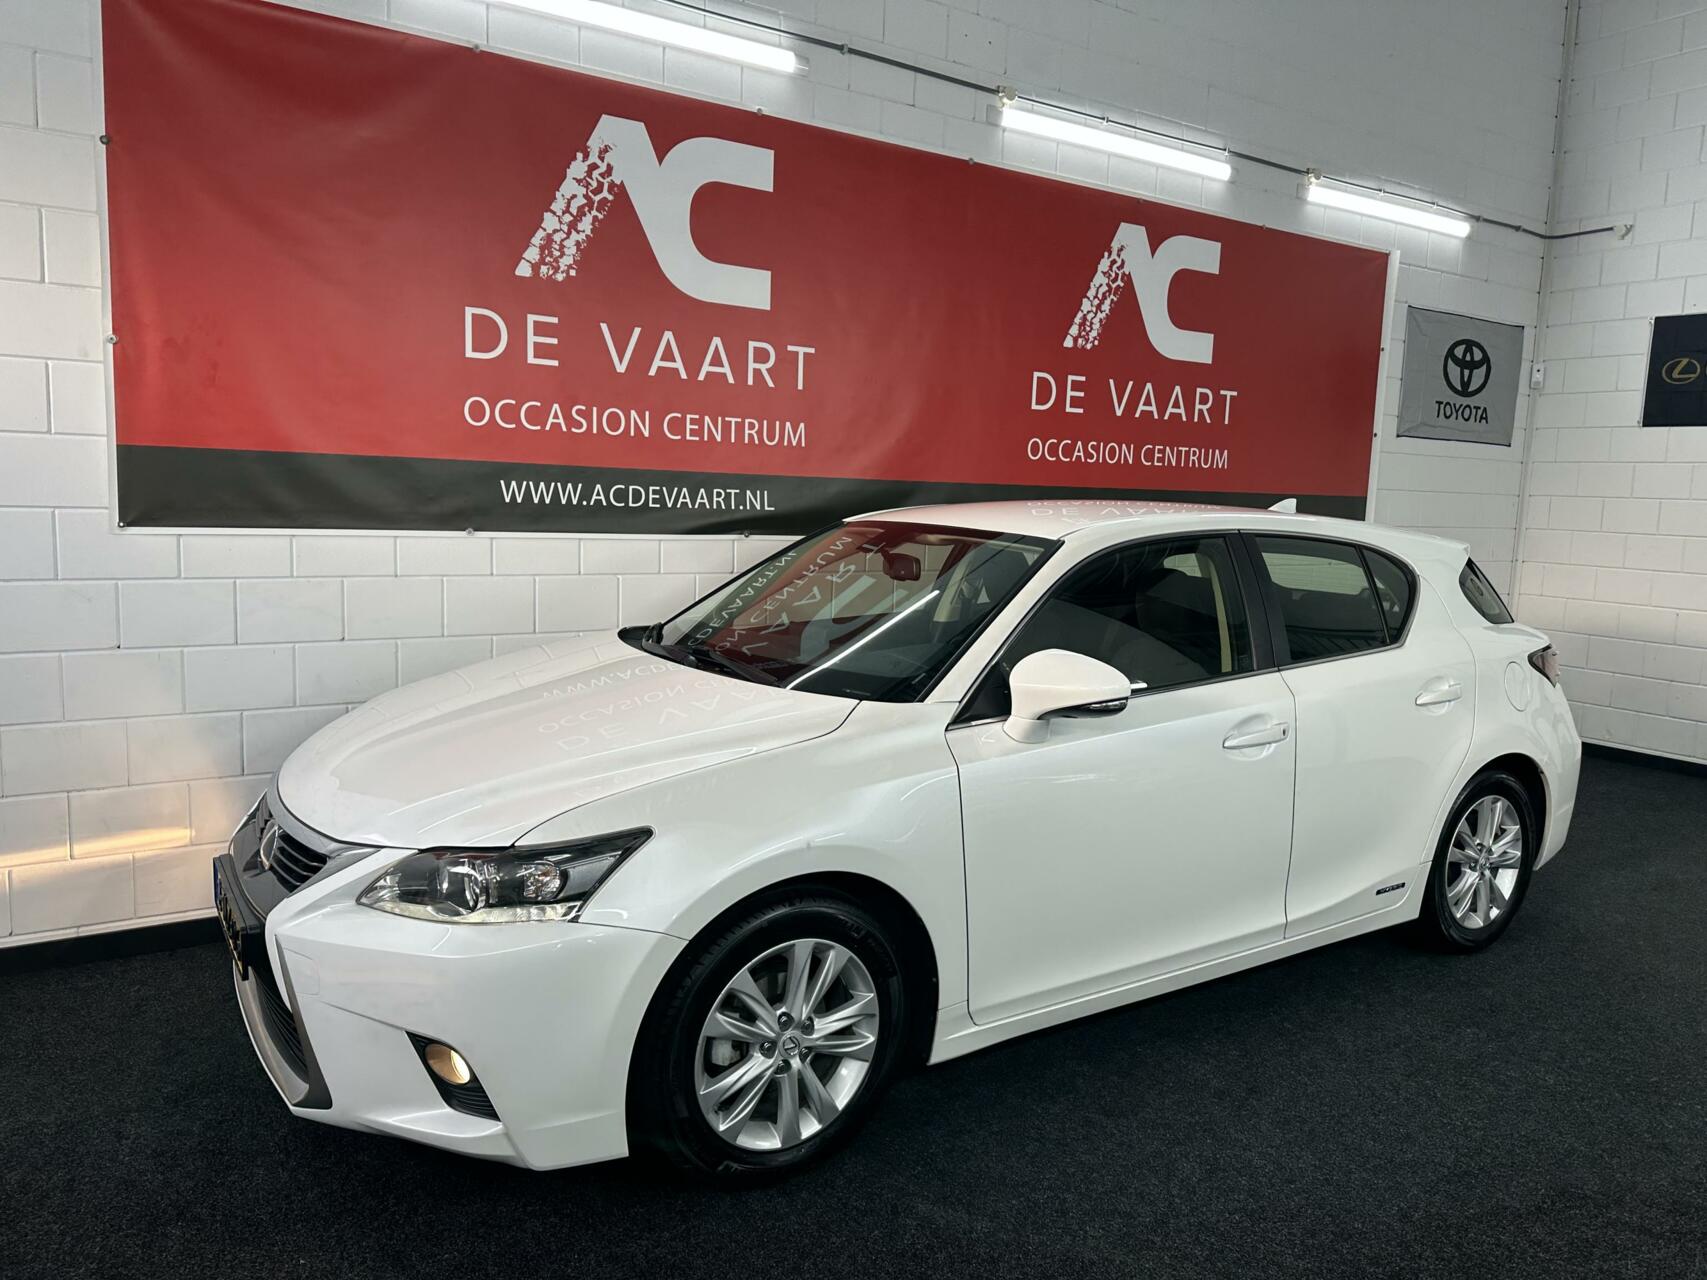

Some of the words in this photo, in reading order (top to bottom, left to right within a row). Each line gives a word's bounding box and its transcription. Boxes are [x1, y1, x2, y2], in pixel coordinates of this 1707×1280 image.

[465, 307, 558, 366] DE
[600, 323, 815, 390] VAART
[1032, 372, 1085, 413] DE
[1109, 379, 1237, 424] VAART
[1434, 400, 1489, 424] TOYOTA
[464, 397, 649, 437] OCCASION
[664, 413, 805, 446] CENTRUM
[1028, 438, 1133, 464] OCCASION
[1141, 445, 1227, 469] CENTRUM
[500, 480, 774, 510] WWW.ACDEVAART.NL
